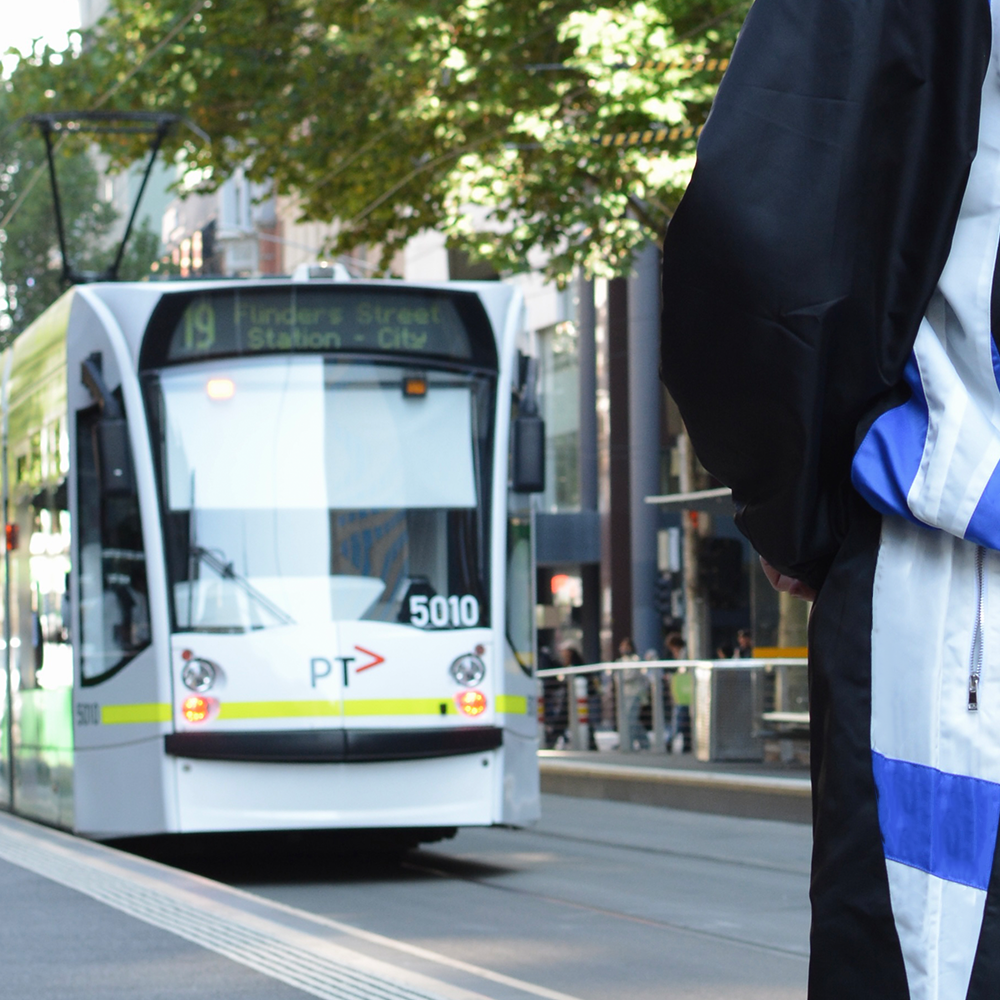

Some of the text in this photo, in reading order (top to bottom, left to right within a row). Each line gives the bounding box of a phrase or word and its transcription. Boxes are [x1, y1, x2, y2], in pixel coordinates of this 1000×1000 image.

[183, 303, 217, 349] 19
[233, 302, 441, 326] Flinders Street
[248, 326, 341, 349] Station
[377, 326, 428, 349] City
[408, 594, 481, 628] 5010
